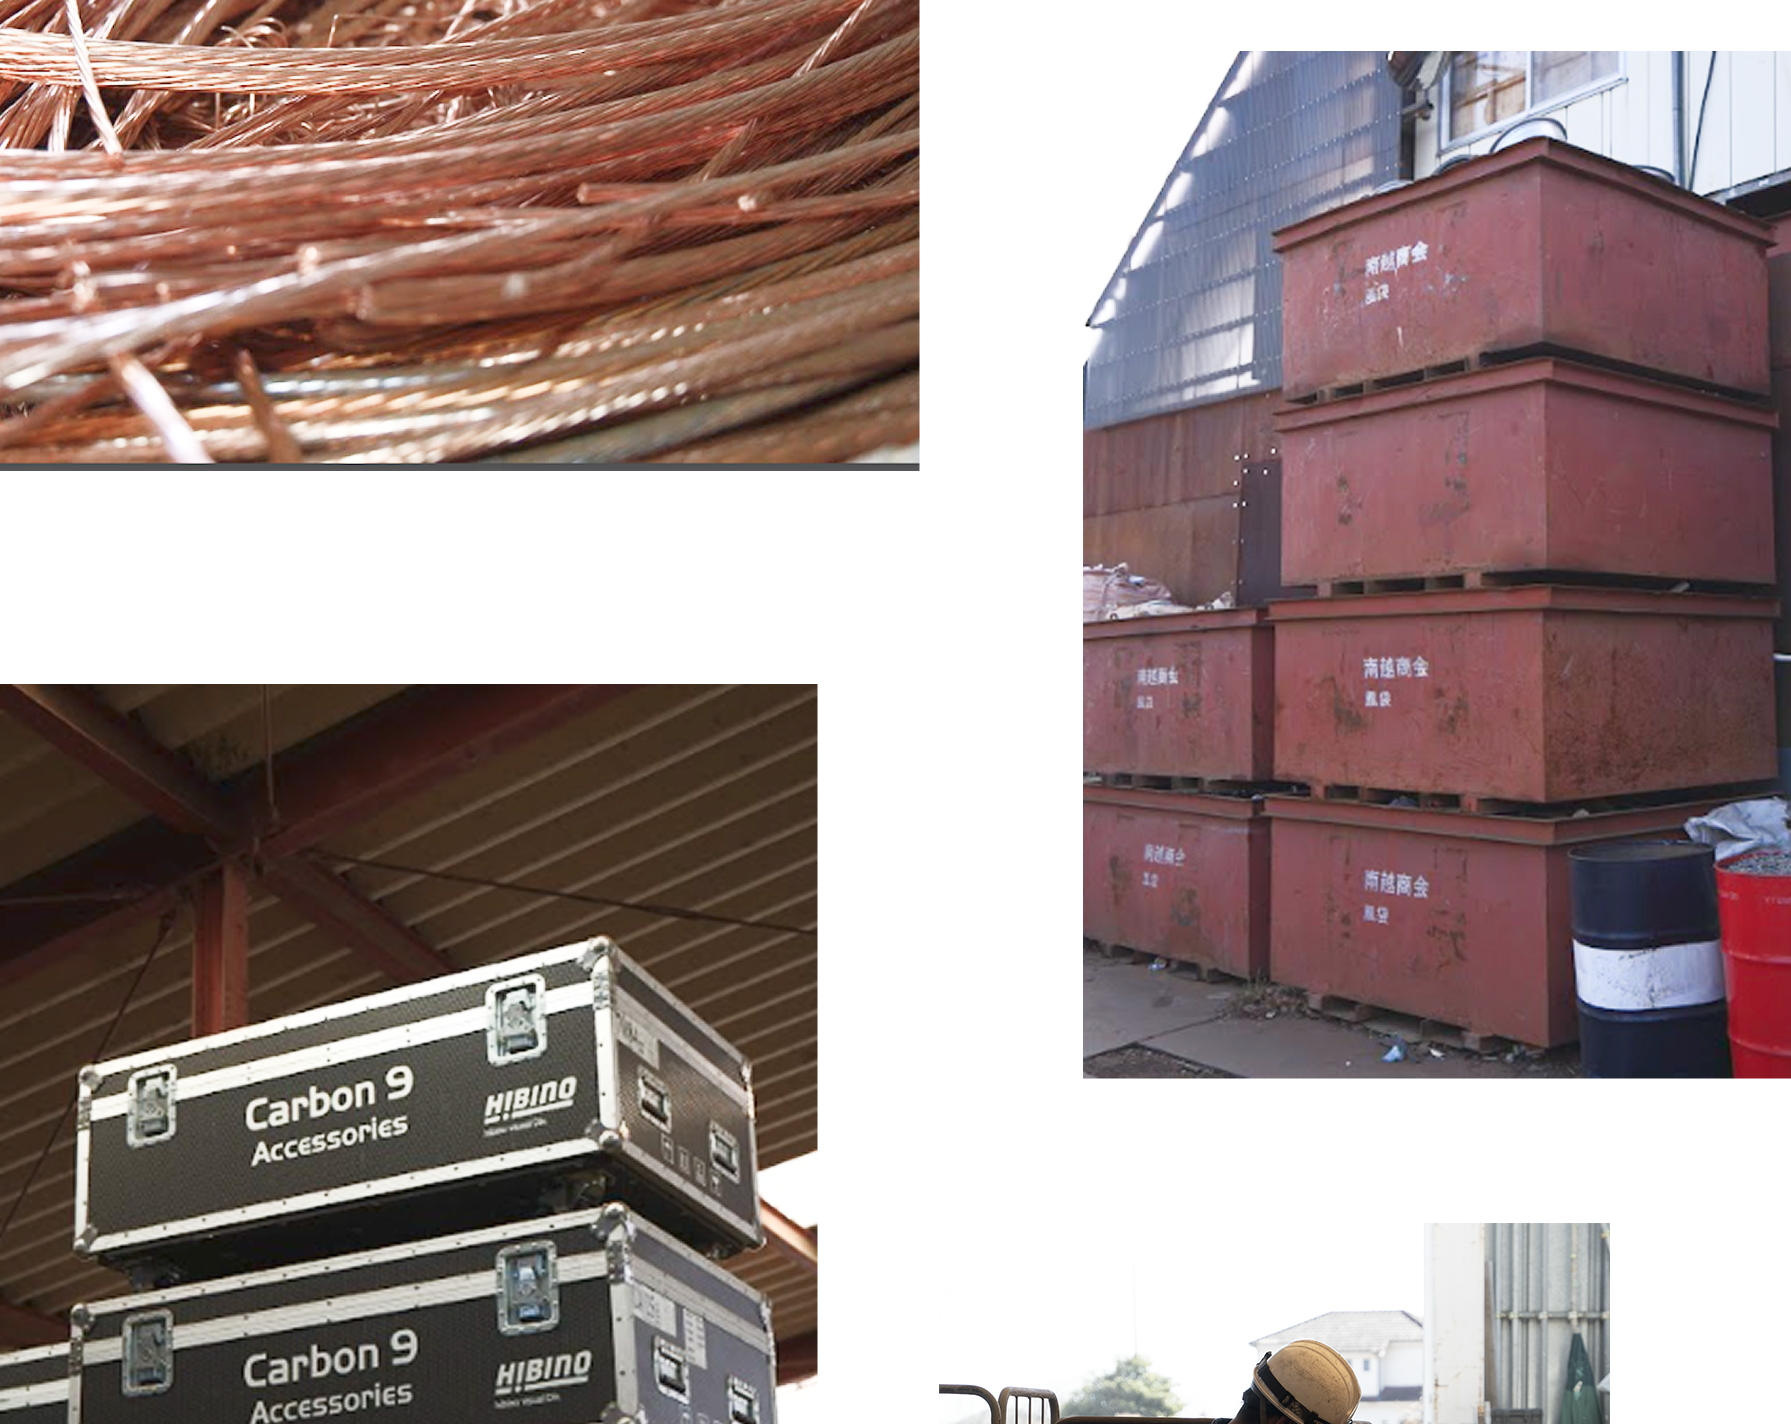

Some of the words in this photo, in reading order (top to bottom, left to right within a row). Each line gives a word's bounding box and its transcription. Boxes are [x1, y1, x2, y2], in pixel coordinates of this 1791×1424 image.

[1363, 656, 1429, 679] 南越商会
[245, 1080, 376, 1131] Carbon
[385, 1065, 414, 1100] 9
[484, 1076, 577, 1121] HIBINO
[251, 1115, 408, 1167] Accessories
[243, 1343, 379, 1388] Carbon
[390, 1329, 418, 1366] 9
[495, 1350, 593, 1393] HIBINO
